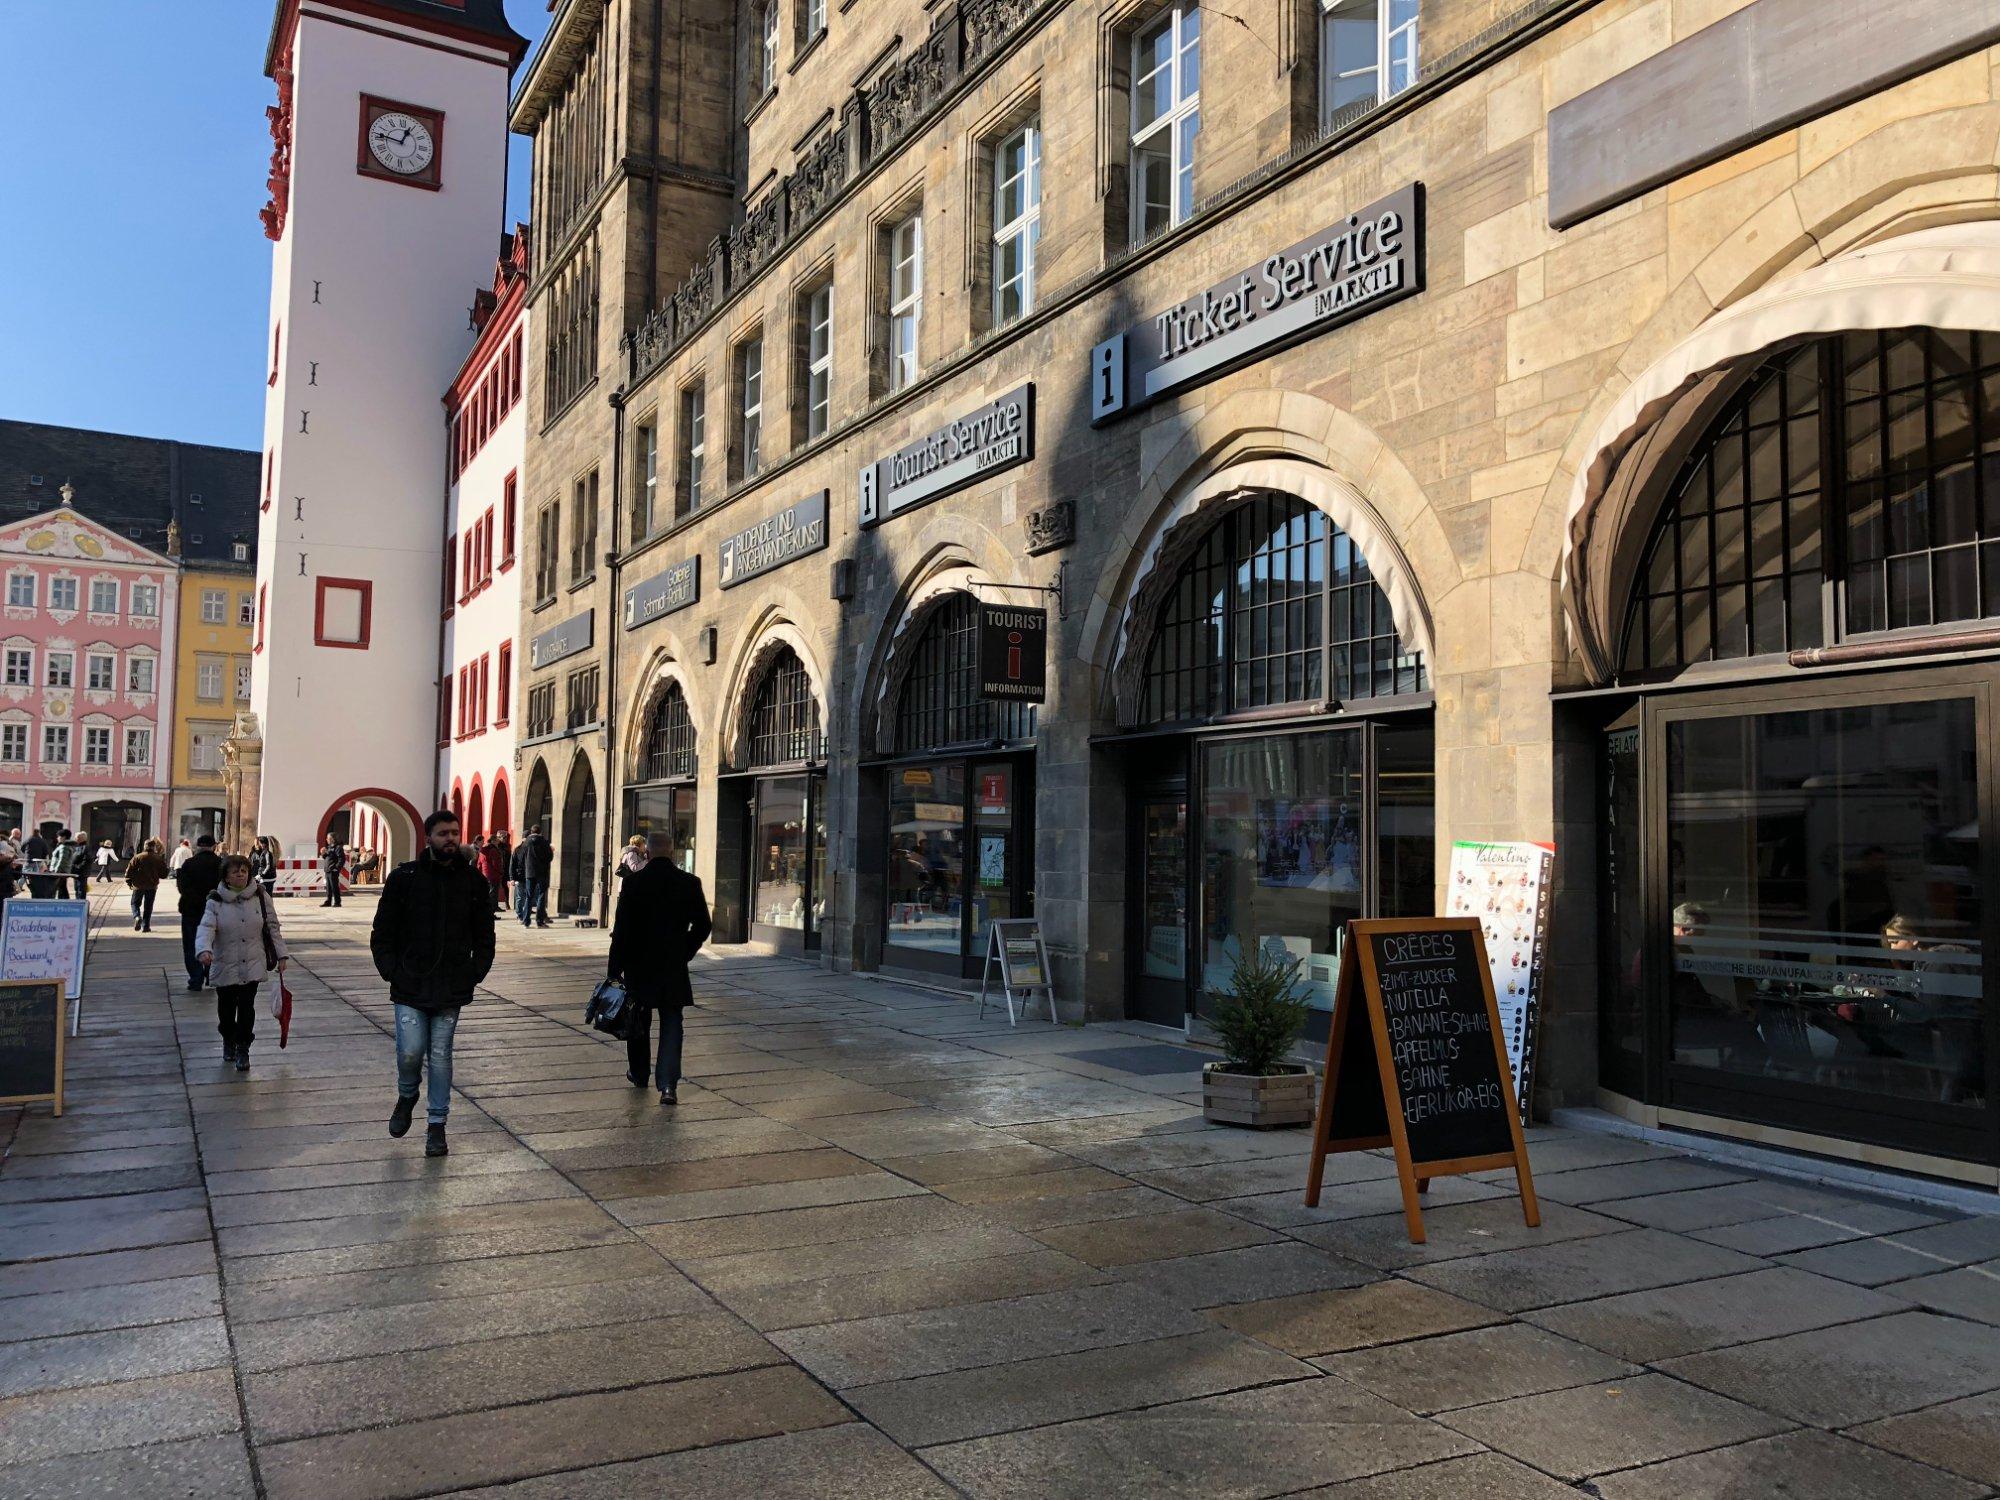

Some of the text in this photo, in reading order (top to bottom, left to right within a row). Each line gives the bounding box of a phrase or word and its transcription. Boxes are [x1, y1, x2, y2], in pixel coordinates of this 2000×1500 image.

[1156, 275, 1253, 360] Ticket
[1261, 210, 1400, 310] Service
[1319, 267, 1382, 315] MARKT
[888, 431, 946, 488] Tourist
[950, 401, 1019, 459] Service
[736, 509, 795, 555] BILDENDE UND
[737, 519, 823, 576] ANGEWANDTE KUNST
[986, 610, 1044, 630] TOURIST
[984, 682, 1043, 695] INFORMATION
[1475, 842, 1531, 864] Valentino
[1384, 933, 1455, 961] CRÊPES
[1381, 968, 1457, 990] ZIMT-ZUCKER
[1836, 971, 1845, 983] &
[1387, 987, 1450, 1014] NUTELLA
[1402, 1065, 1451, 1091] SAHNE
